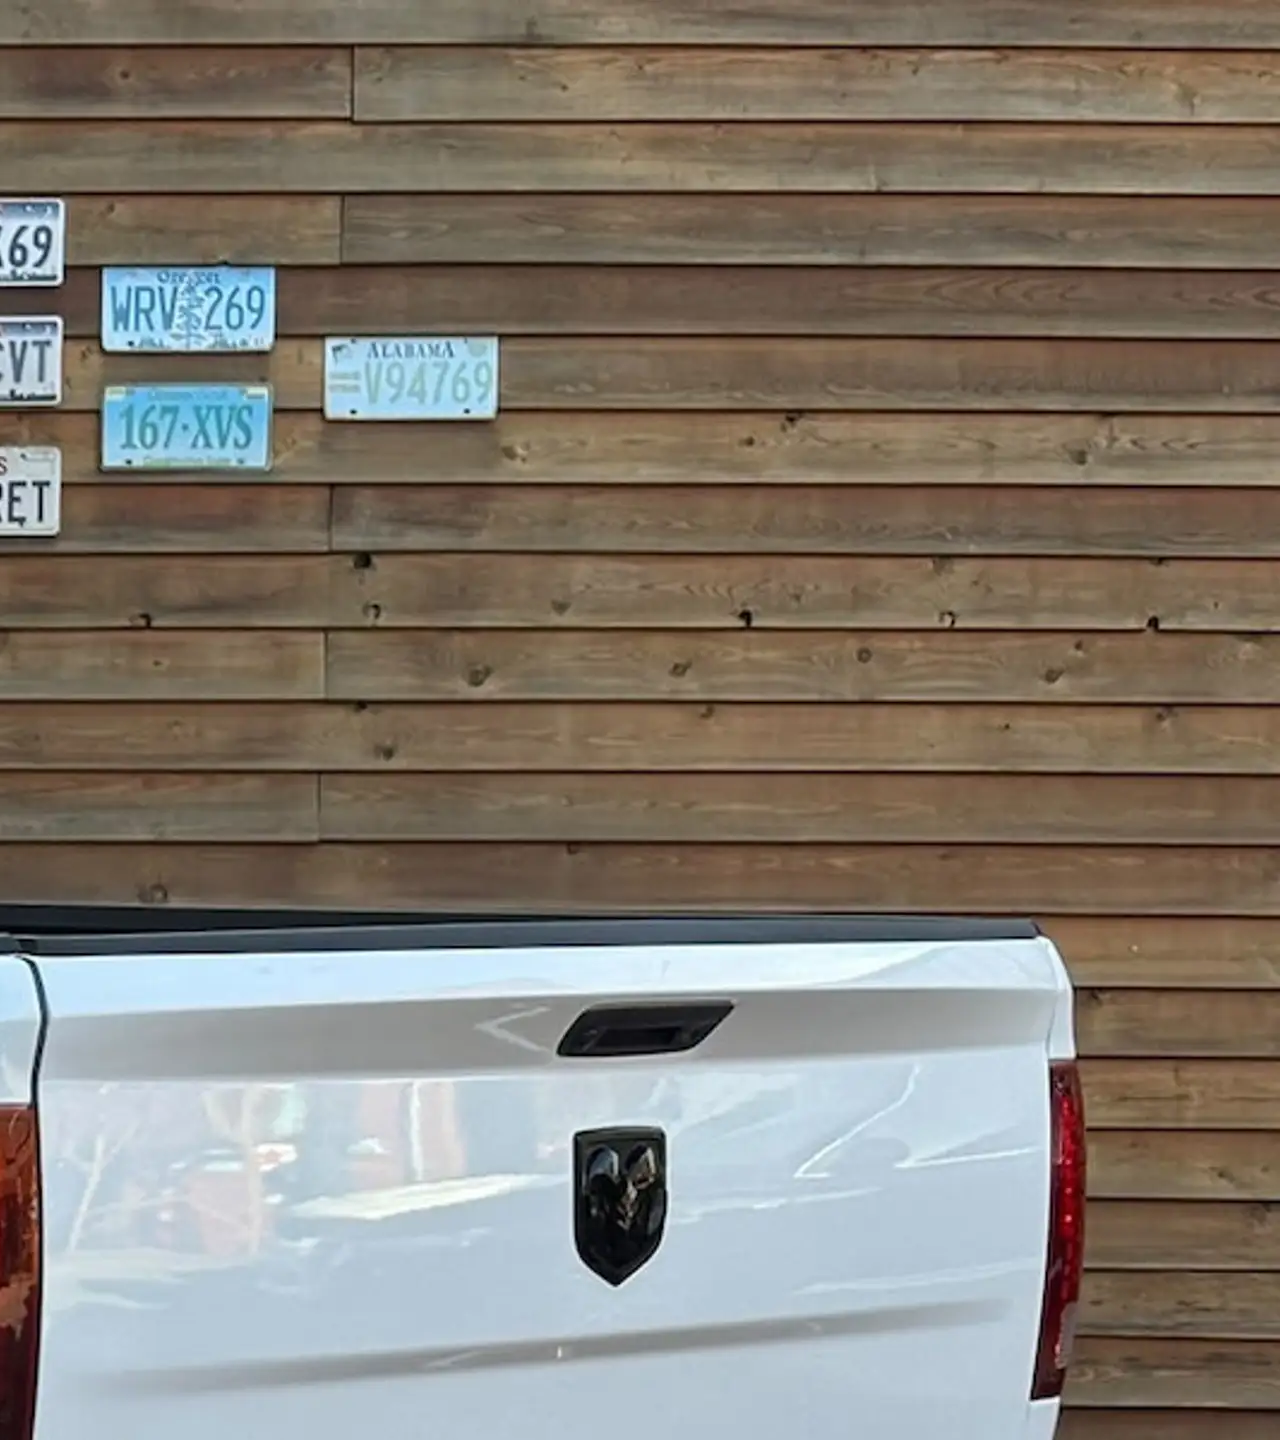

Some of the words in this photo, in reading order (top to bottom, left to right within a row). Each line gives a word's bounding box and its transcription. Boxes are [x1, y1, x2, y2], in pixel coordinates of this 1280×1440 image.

[111, 286, 179, 332] WRV
[204, 286, 265, 331] 269
[367, 341, 455, 359] ALABAMA
[365, 361, 492, 405] V94769
